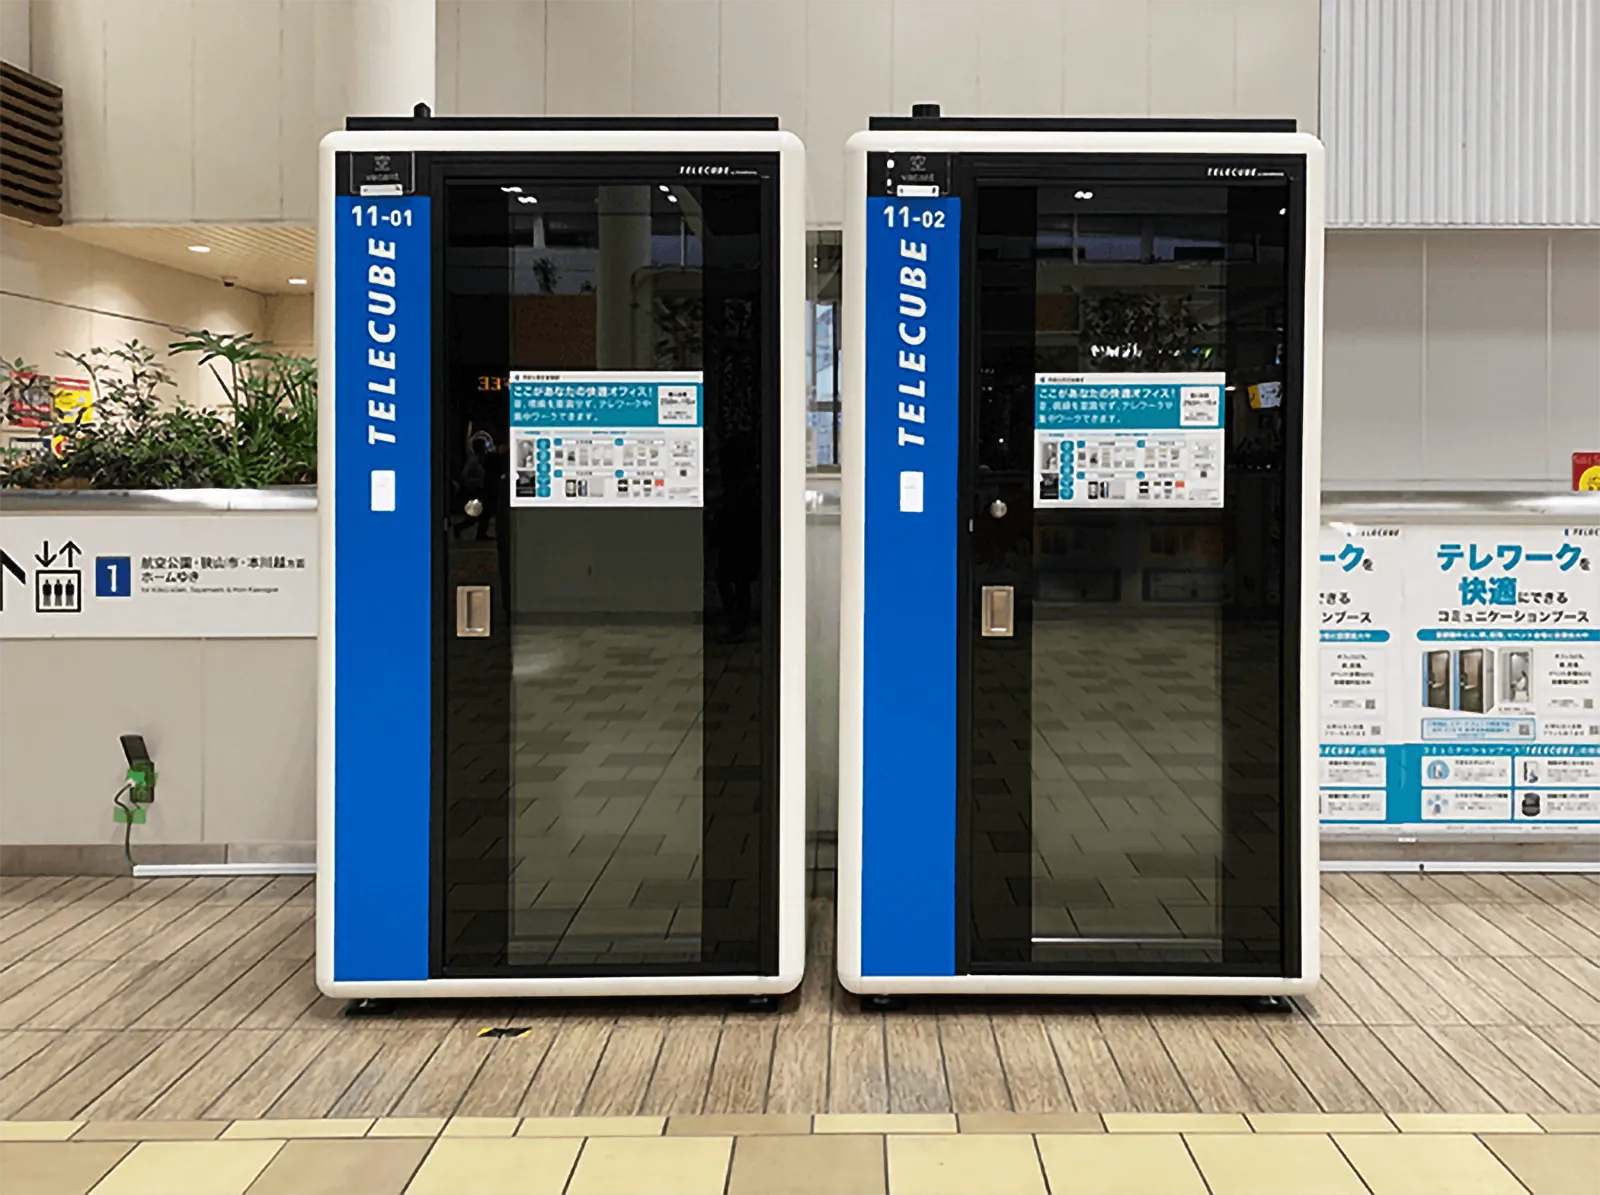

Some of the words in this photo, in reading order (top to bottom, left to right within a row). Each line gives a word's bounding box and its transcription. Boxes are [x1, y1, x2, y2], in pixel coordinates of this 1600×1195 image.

[680, 166, 729, 175] TELECUBE
[351, 205, 412, 227] 11-01
[883, 205, 945, 229] 11-02
[367, 237, 397, 445] TELECUBE
[898, 238, 927, 447] TELECUBE
[106, 564, 118, 593] 1
[1319, 592, 1351, 605] きる
[1438, 610, 1589, 623] コミュニケーションブース
